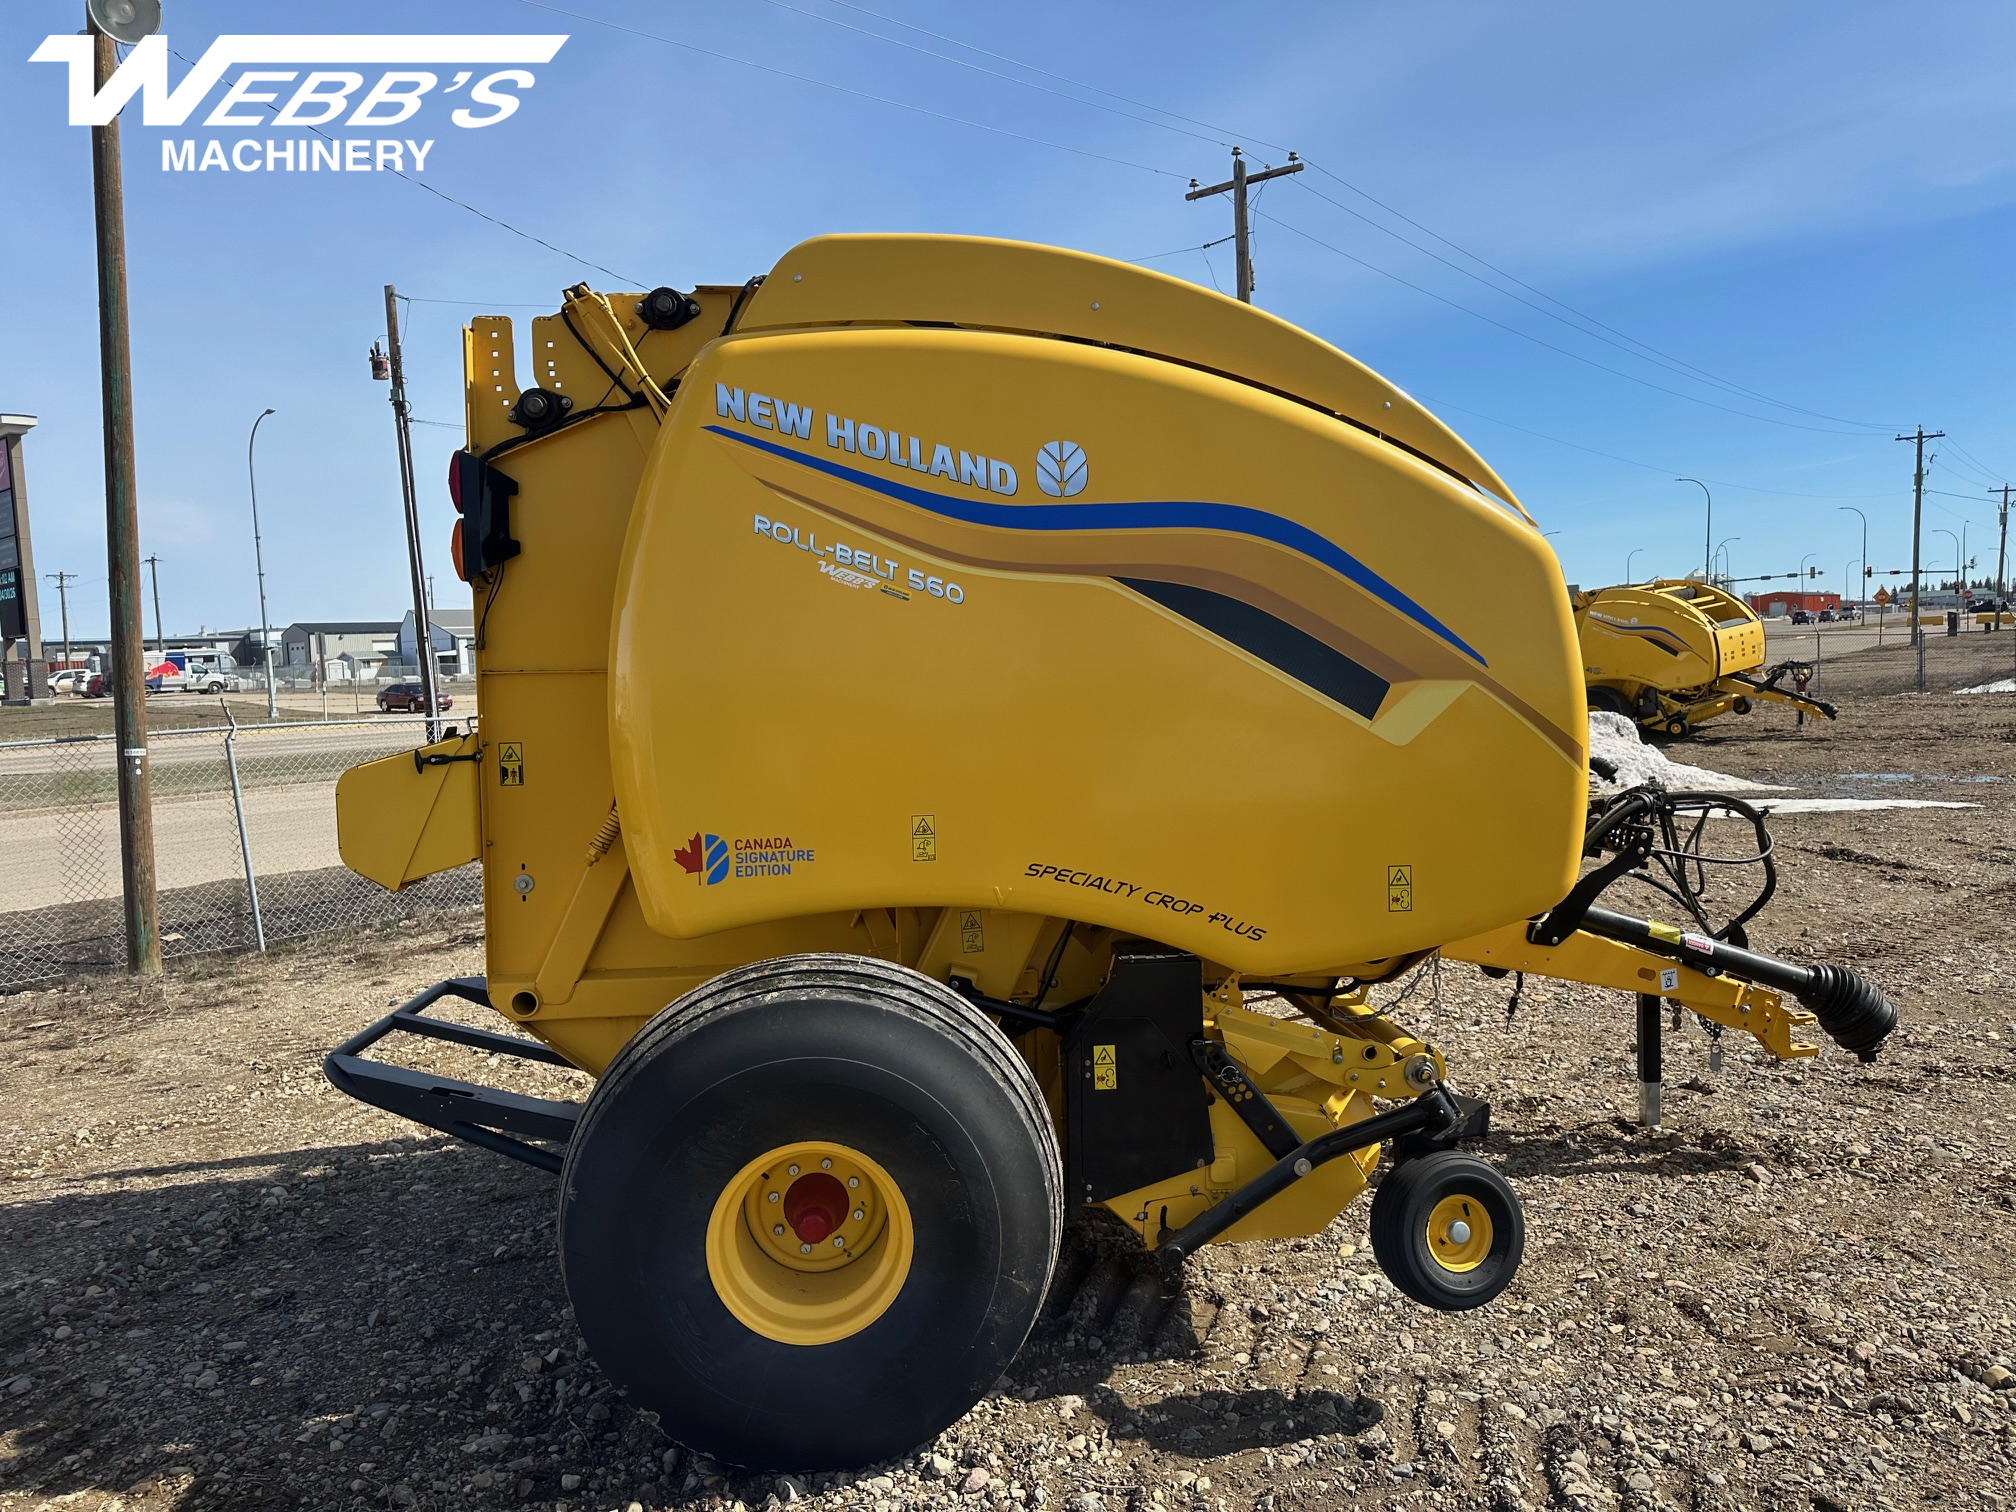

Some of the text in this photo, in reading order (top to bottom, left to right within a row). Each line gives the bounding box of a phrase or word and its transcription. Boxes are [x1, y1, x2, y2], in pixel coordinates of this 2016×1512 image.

[715, 382, 1018, 496] NEW HOLLAND
[753, 513, 965, 605] ROLL-BELT 560
[817, 560, 881, 589] WEBB'S
[830, 576, 860, 590] MACHINERY
[1589, 610, 1629, 625] NEW HOLLAND
[734, 837, 793, 851] CANADA
[735, 849, 815, 864] SIGNATURE
[735, 863, 792, 878] EDITION
[1024, 862, 1142, 898] SPECIALTY
[1143, 891, 1205, 916] CROP
